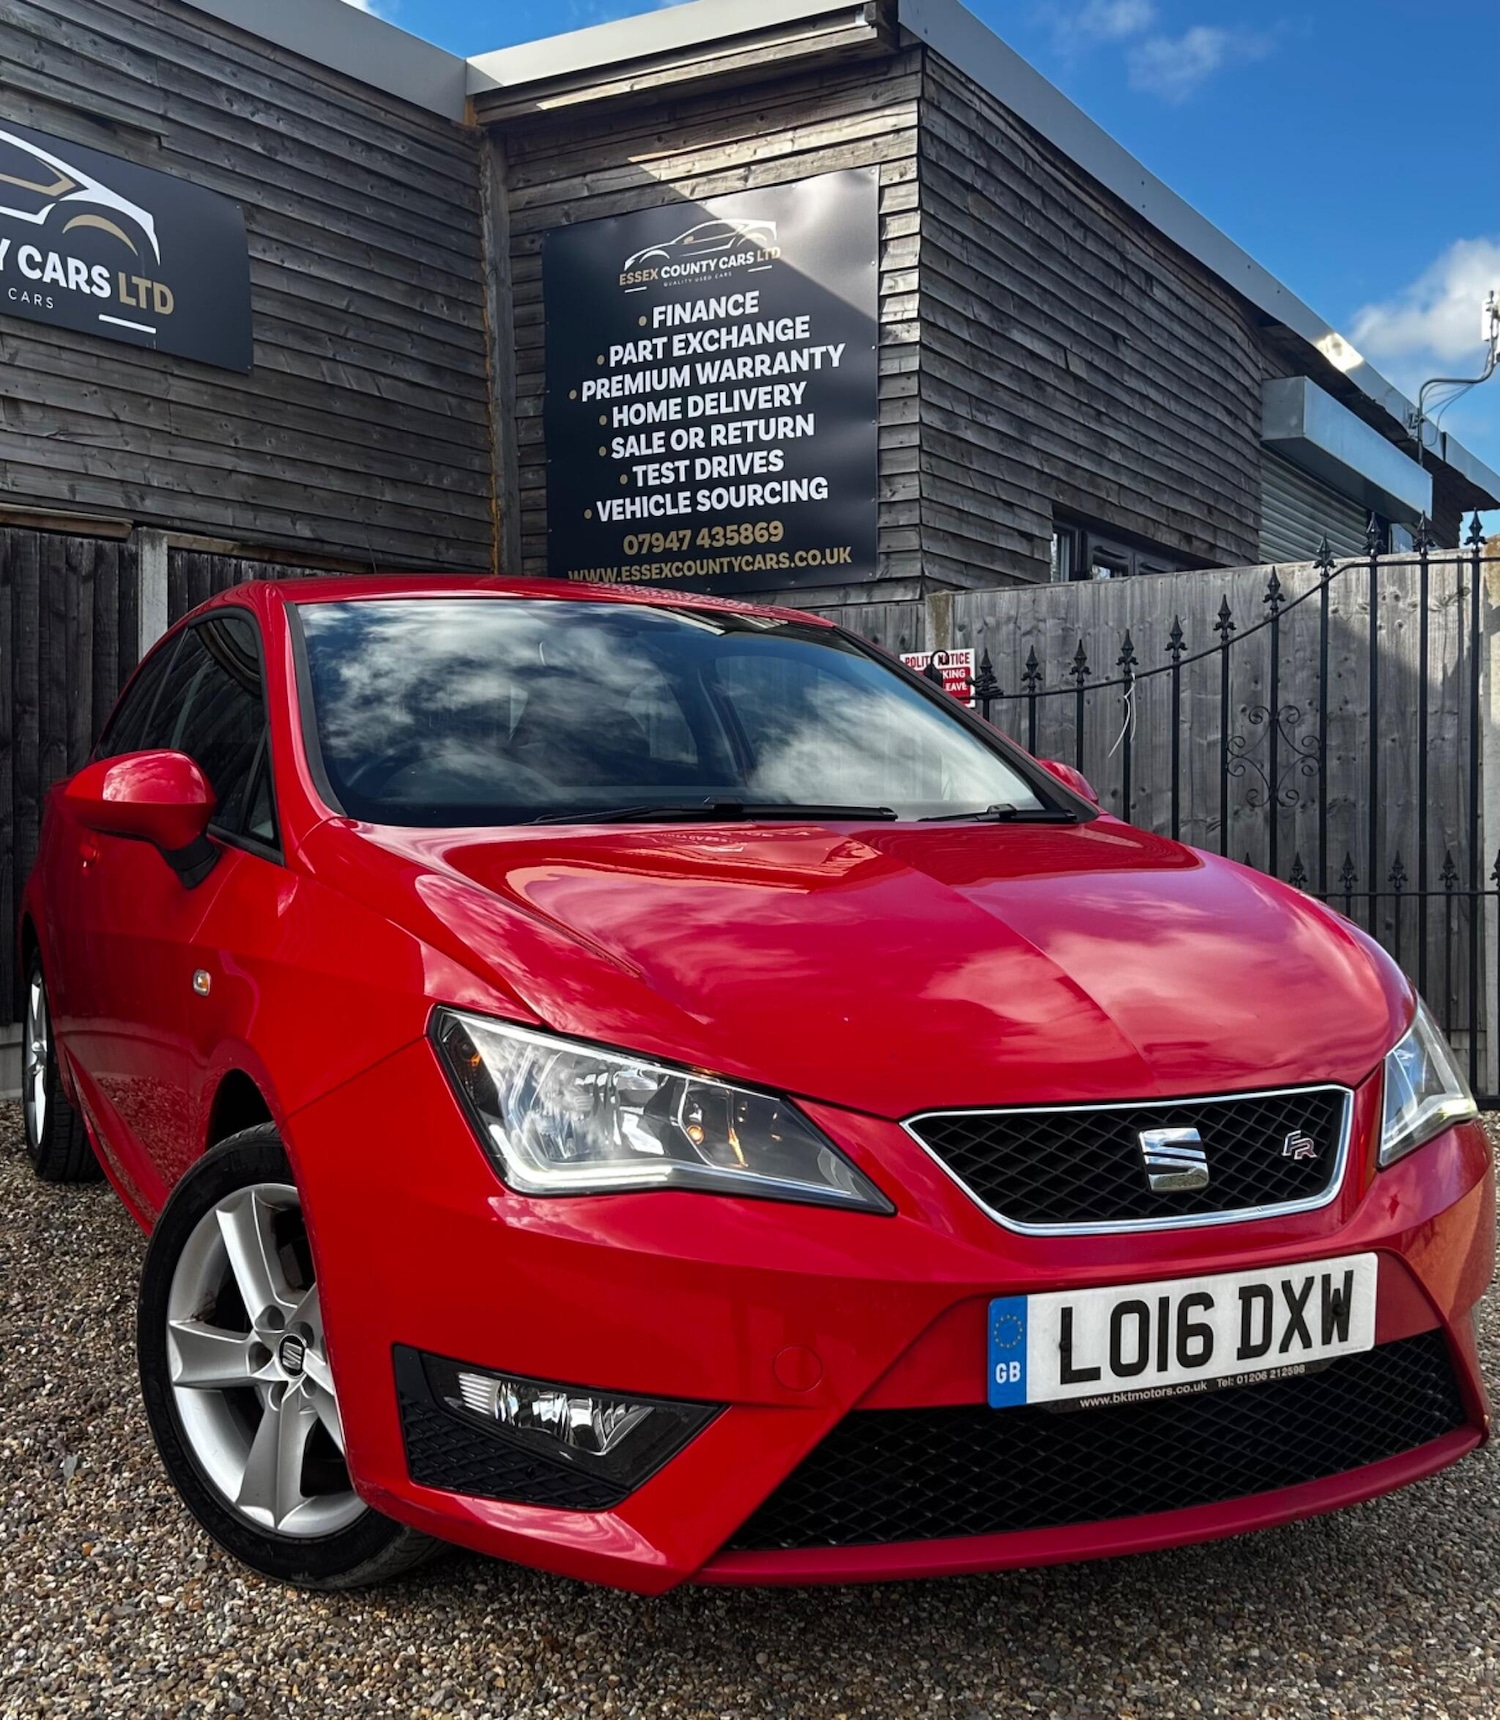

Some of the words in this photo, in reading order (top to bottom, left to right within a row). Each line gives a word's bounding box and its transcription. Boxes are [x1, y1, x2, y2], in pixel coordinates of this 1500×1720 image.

[17, 245, 112, 298] CARS
[118, 272, 175, 315] LTD
[619, 268, 658, 286] ESSEX
[661, 258, 718, 279] COUNTY
[719, 251, 754, 269] CARS
[756, 247, 781, 262] LTD
[663, 278, 692, 287] QUALITY
[714, 271, 732, 279] CARS
[8, 288, 54, 309] CARS
[652, 290, 760, 329] FINANCE
[609, 337, 668, 367] PART
[672, 315, 811, 357] EXCHANGE
[581, 365, 691, 402] PREMIUM
[695, 343, 846, 385] WARRANTY
[612, 398, 682, 428] HOME
[688, 381, 807, 418] DELIVERY
[611, 431, 665, 459] SALE
[670, 427, 705, 451] OR
[710, 413, 815, 447] RETURN
[632, 460, 690, 487] TEST
[695, 449, 784, 481] DRIVES
[596, 491, 692, 522] VEHICLE
[696, 477, 829, 512] SOURCING
[623, 529, 692, 555] 07947
[696, 520, 784, 548] 435869
[568, 546, 853, 583] WWW.ESSEXCOUNTYCARS.CO.UK
[905, 656, 932, 668] POLIT
[1058, 1291, 1215, 1385] LO16
[1236, 1269, 1354, 1361] DXW
[995, 1362, 1021, 1384] GB
[1079, 1381, 1208, 1408] www.bktmotors.co.uk
[1216, 1377, 1235, 1388] Tel:
[1236, 1372, 1268, 1385] 01206
